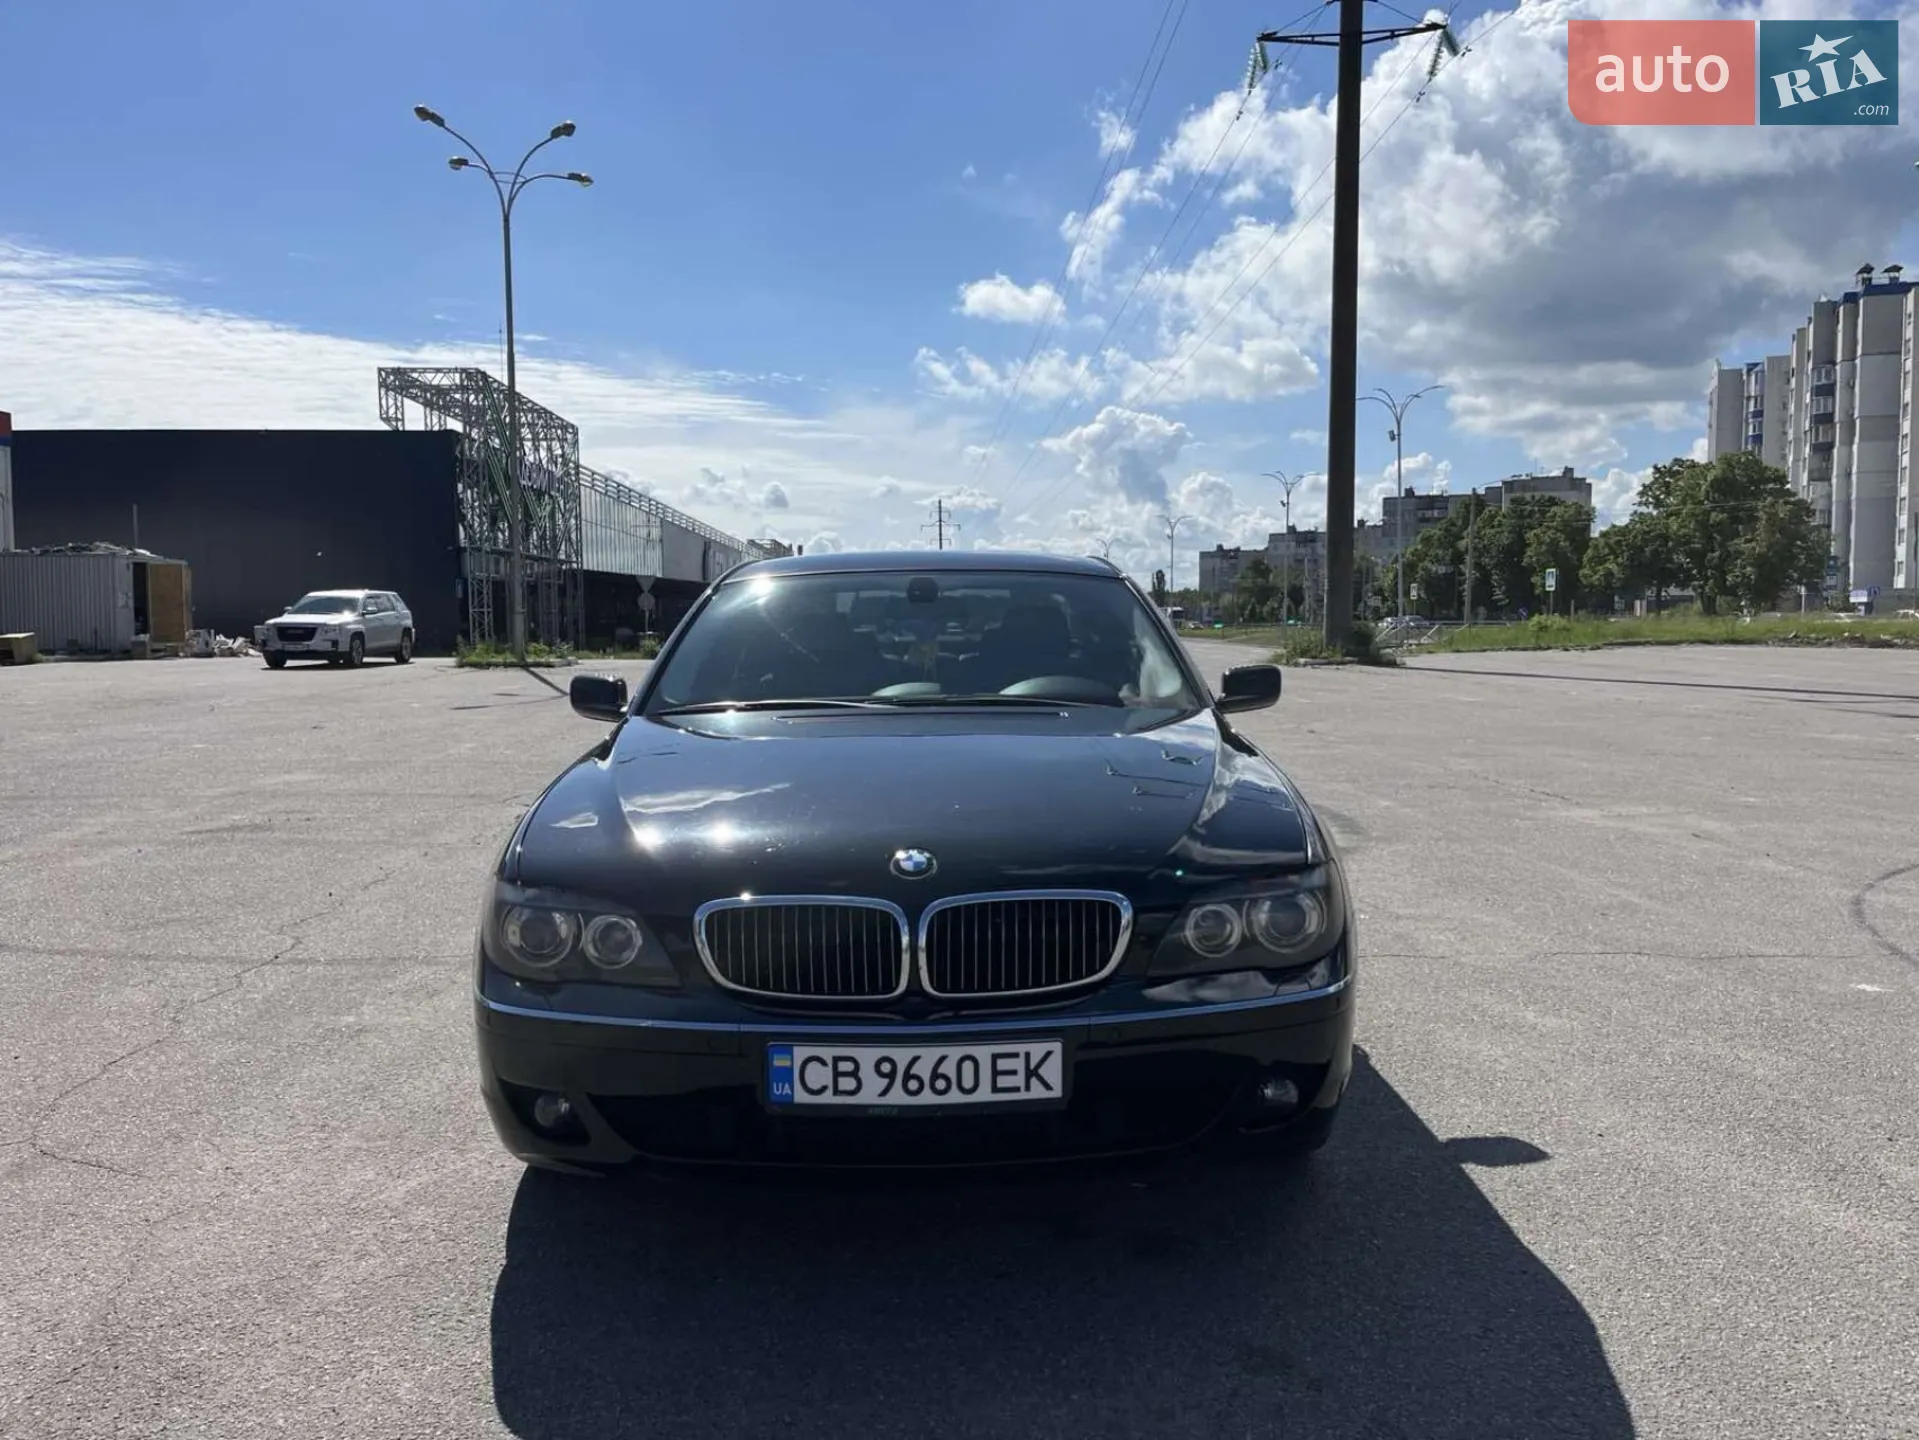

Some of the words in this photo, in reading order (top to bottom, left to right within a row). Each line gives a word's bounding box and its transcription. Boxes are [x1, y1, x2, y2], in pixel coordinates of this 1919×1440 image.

[798, 1055, 864, 1097] CB
[873, 1053, 980, 1097] 9660
[990, 1050, 1055, 1094] EK
[772, 1083, 792, 1096] UA
